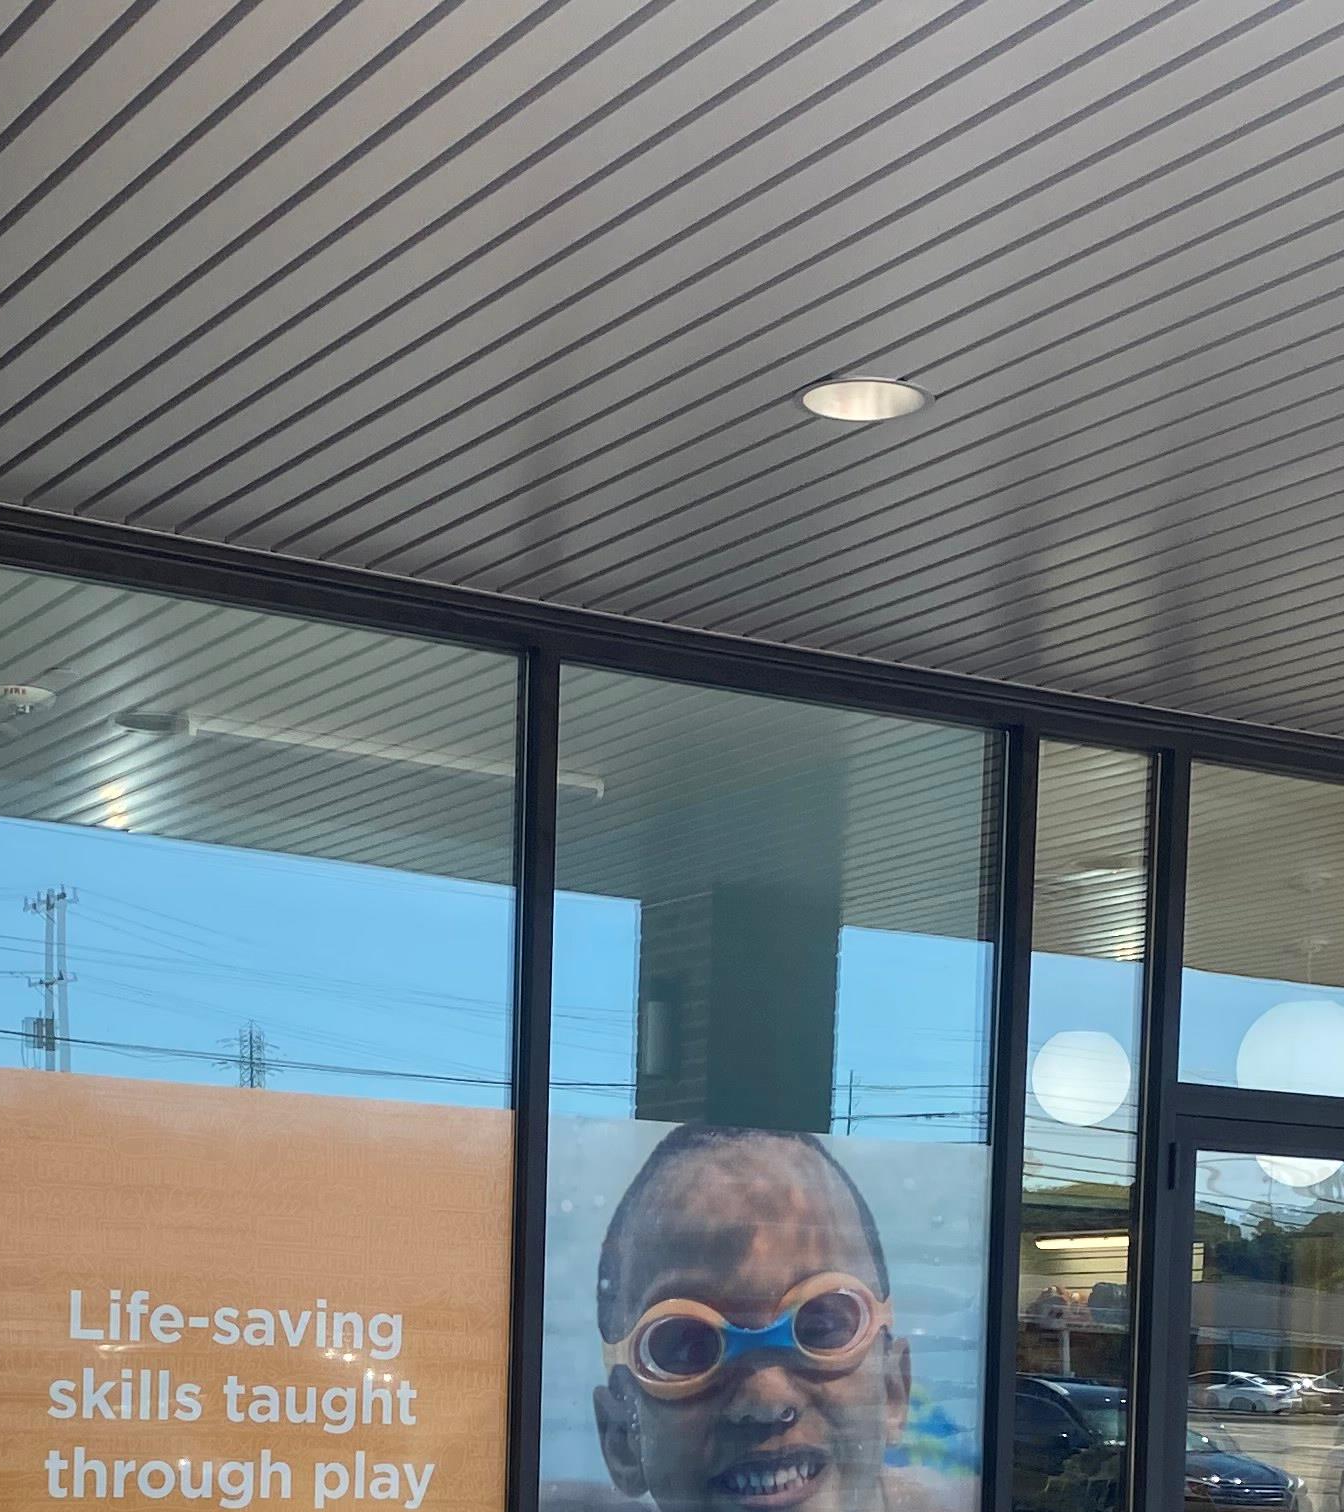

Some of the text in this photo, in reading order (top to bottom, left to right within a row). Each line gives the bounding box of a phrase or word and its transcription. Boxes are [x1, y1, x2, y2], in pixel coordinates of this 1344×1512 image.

[69, 1289, 403, 1360] Life-saving
[47, 1367, 417, 1434] skills taught
[44, 1446, 436, 1509] through play
